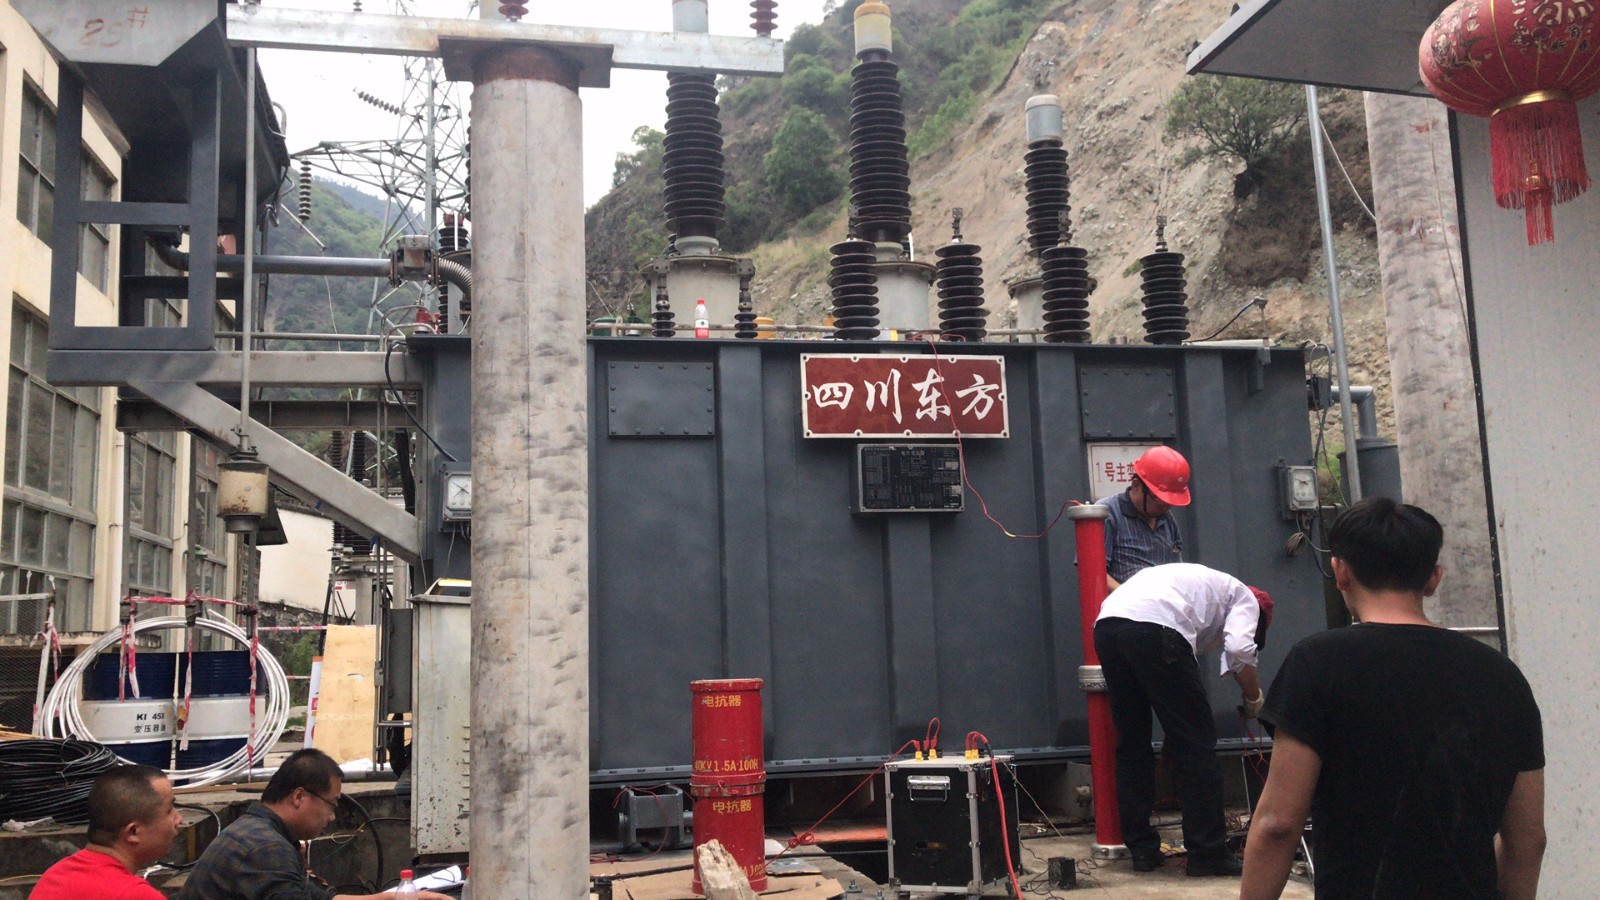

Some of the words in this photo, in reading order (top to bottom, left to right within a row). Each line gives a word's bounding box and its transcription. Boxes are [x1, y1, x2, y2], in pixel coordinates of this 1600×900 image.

[811, 367, 999, 425] 四川东方
[702, 694, 741, 708] 电抗器
[712, 799, 752, 815] 电抗器
